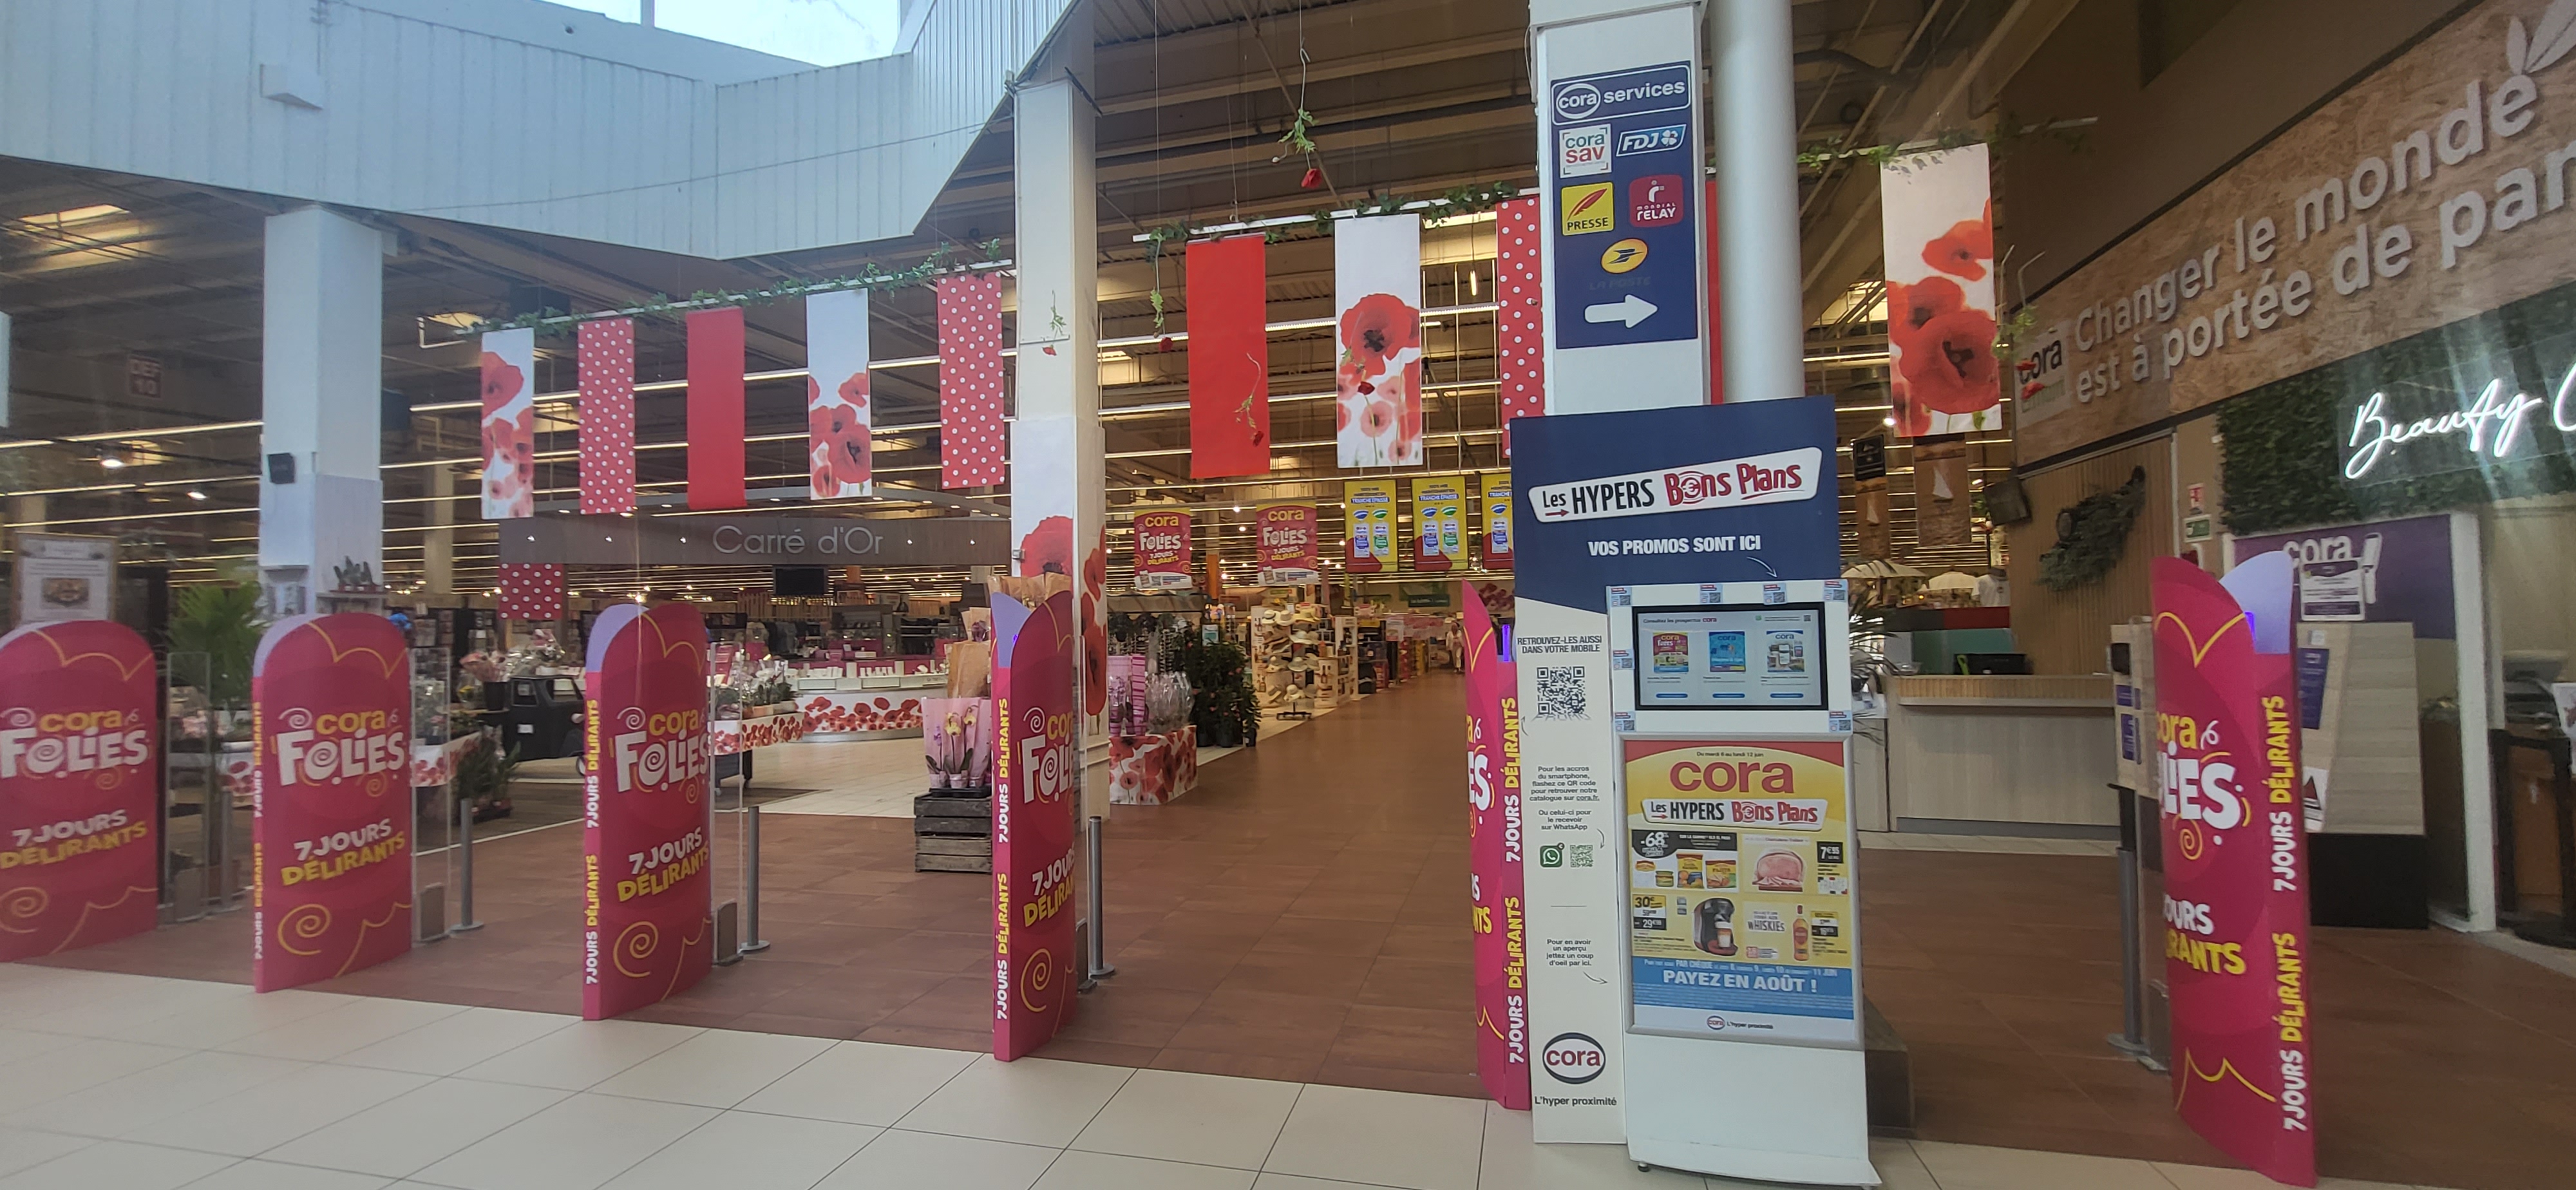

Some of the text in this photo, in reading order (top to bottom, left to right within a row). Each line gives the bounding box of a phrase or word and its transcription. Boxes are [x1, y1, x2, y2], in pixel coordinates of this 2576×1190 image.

[1558, 80, 1685, 109] cora services
[1566, 134, 1604, 149] cora
[1566, 146, 1604, 164] sav
[1622, 133, 1658, 151] FDJ
[1567, 217, 1609, 231] PRESSE
[2074, 73, 2539, 353] Changer le monde
[2076, 359, 2121, 405] est
[2132, 337, 2149, 382] à
[2162, 266, 2312, 379] portée
[2332, 223, 2412, 296] de
[2345, 378, 2542, 478] Beauty
[1542, 489, 1566, 509] Les
[1571, 478, 1654, 515] HYPERS
[1737, 462, 1802, 495] Plans
[1145, 516, 1179, 527] cora
[1268, 510, 1304, 521] cora
[713, 525, 884, 555] Carré d'Or
[1588, 535, 1761, 556] VOS PROMOS SONT ICI
[2283, 536, 2352, 568] cora
[1517, 636, 1578, 645] RETROUVEZ-LES
[40, 710, 122, 732] cora
[316, 710, 385, 735] cora
[586, 700, 600, 770] DÉLIRANTS
[649, 710, 699, 736] cora
[998, 697, 1010, 778] DÉLIRANTS
[1501, 697, 1520, 788] DÉLIRANTS
[2261, 696, 2295, 804] DÉLIRANTS
[1669, 760, 1794, 793] cora
[1651, 802, 1667, 813] Les
[1670, 802, 1725, 820] HYPERS
[1777, 802, 1818, 822] Plans
[281, 831, 405, 885] DÉLIRANTS
[586, 855, 600, 926] DÉLIRANTS
[996, 873, 1009, 955] DÉLIRANTS
[1748, 921, 1785, 931] WHISKIES
[1503, 897, 1524, 988] DÉLIRANTS
[1663, 970, 1721, 987] PAYEZ
[1724, 974, 1749, 988] EN
[1754, 974, 1804, 992] AOÛT
[2271, 932, 2305, 1043] DÉLIRANTS
[1546, 1050, 1600, 1066] cora
[1535, 1095, 1617, 1106] L'hyper proximité
